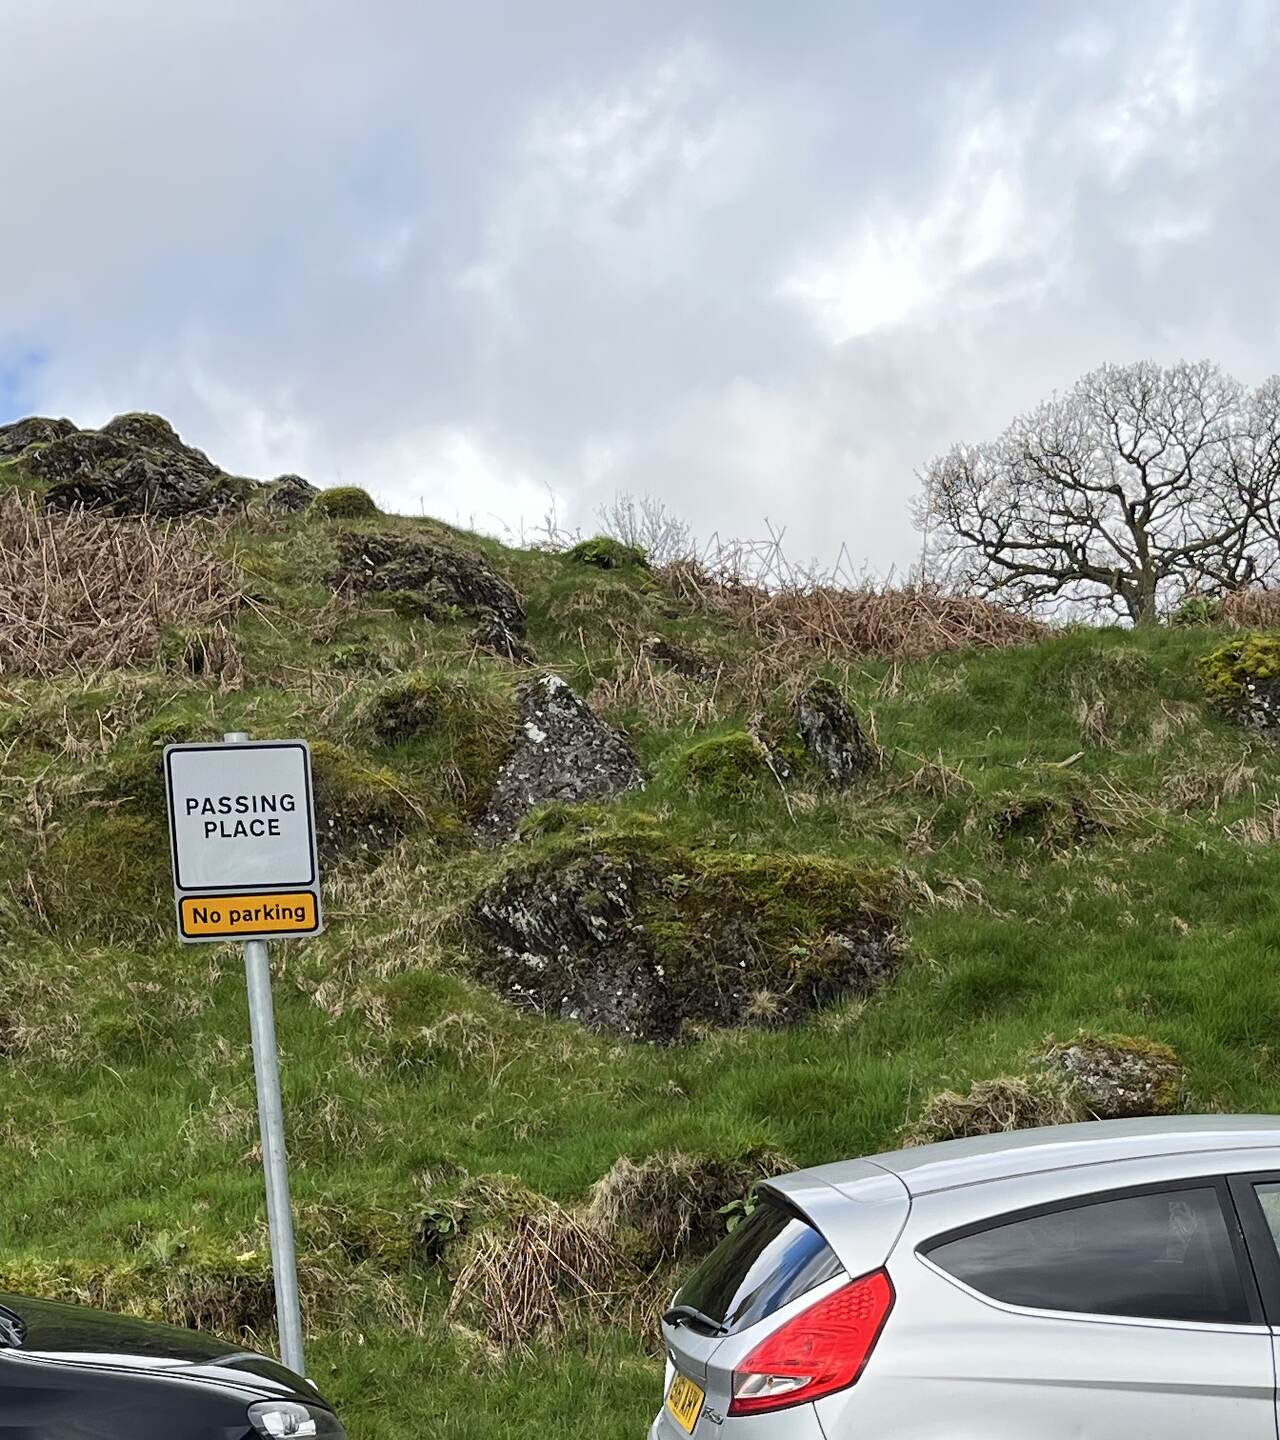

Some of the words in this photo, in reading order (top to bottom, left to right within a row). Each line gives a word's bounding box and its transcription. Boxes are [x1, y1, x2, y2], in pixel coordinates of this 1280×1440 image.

[186, 794, 295, 816] PASSING
[204, 819, 280, 838] PLACE
[192, 907, 221, 924] No
[229, 904, 305, 926] parking
